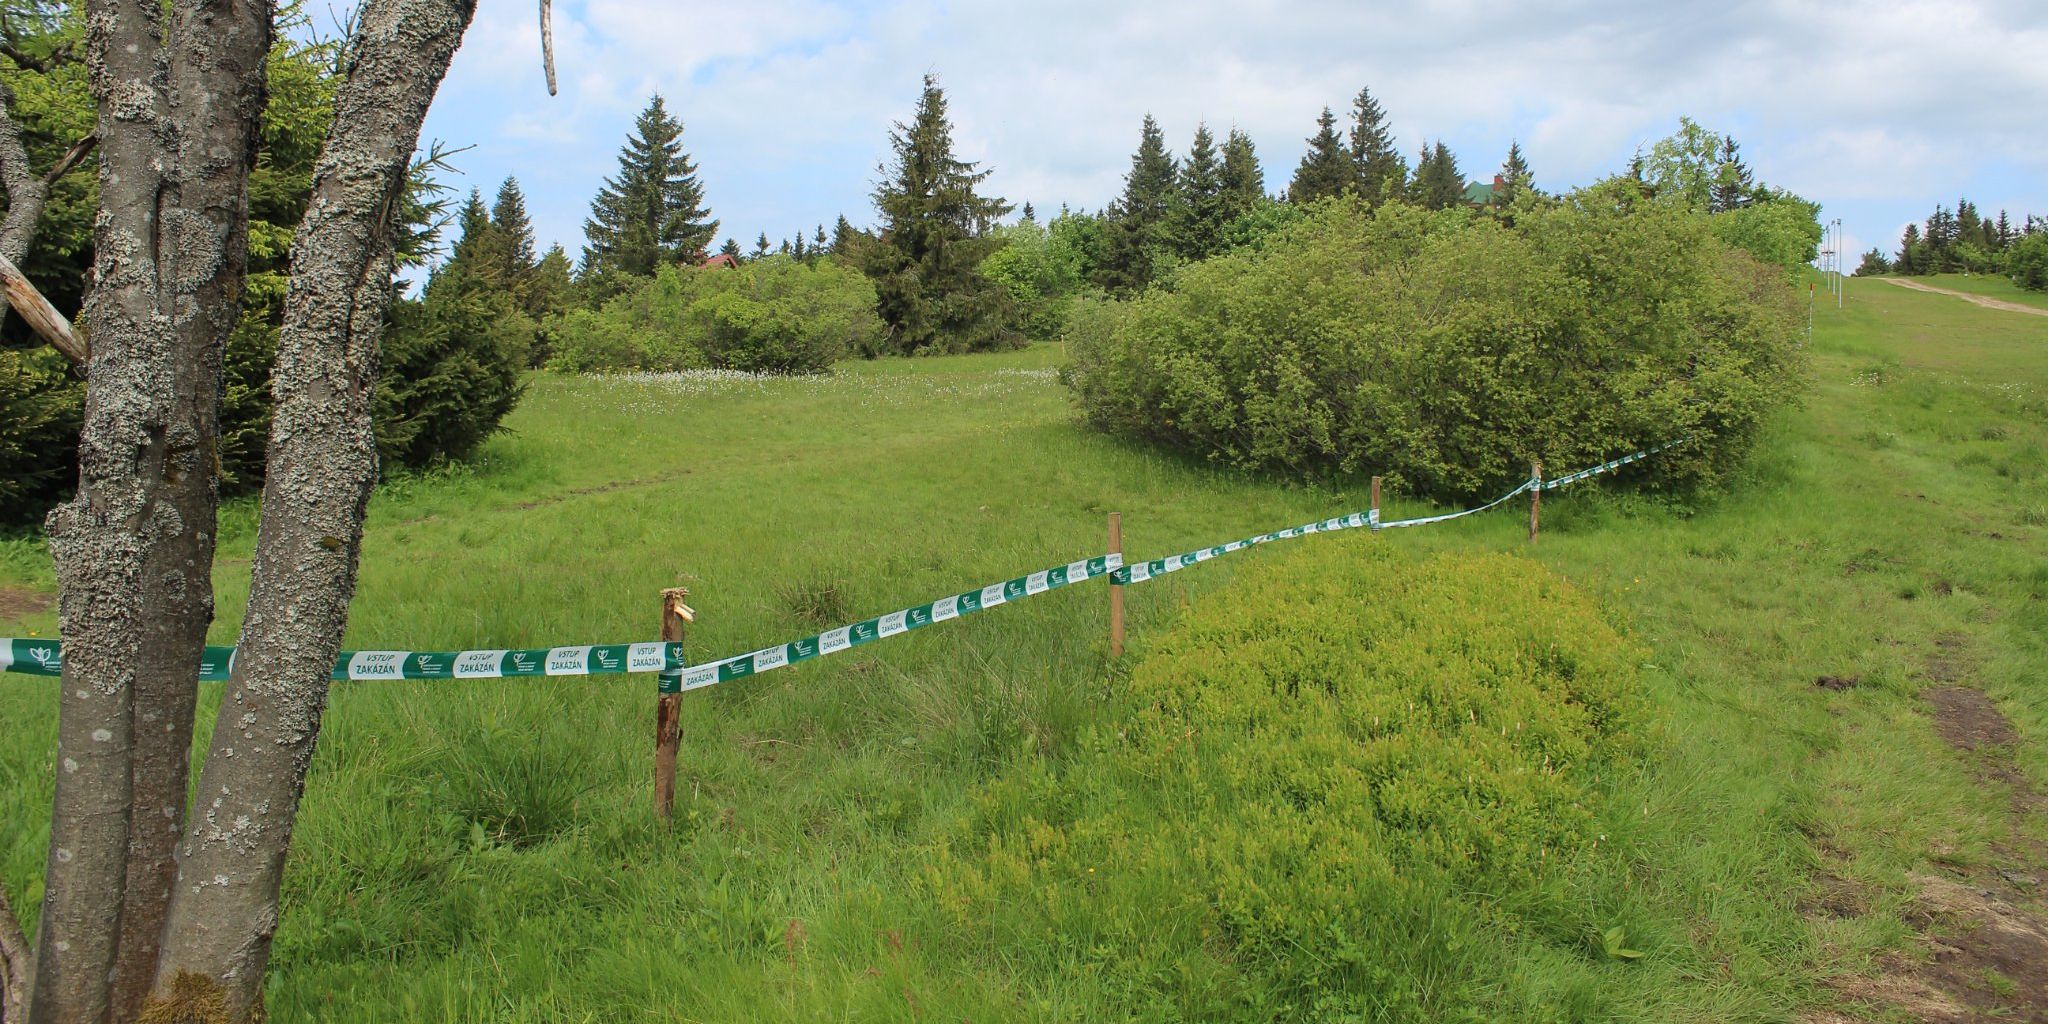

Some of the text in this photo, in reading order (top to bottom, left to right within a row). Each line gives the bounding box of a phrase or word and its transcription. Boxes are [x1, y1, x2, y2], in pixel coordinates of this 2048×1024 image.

[823, 637, 846, 649] ZAKÁZÁN
[558, 650, 580, 658] VSTUP
[637, 647, 657, 655] VSTUP
[366, 654, 395, 662] VSTUP
[468, 653, 494, 661] VSTUP
[632, 657, 661, 667] ZAKÁZÁN
[758, 654, 783, 666] ZAKÁZÁN
[356, 663, 395, 674] ZAKÁZÁN
[460, 662, 494, 673] ZAKÁZÁN
[551, 659, 582, 670] ZAKÁZÁN
[686, 671, 714, 686] ZAKÁZÁN
